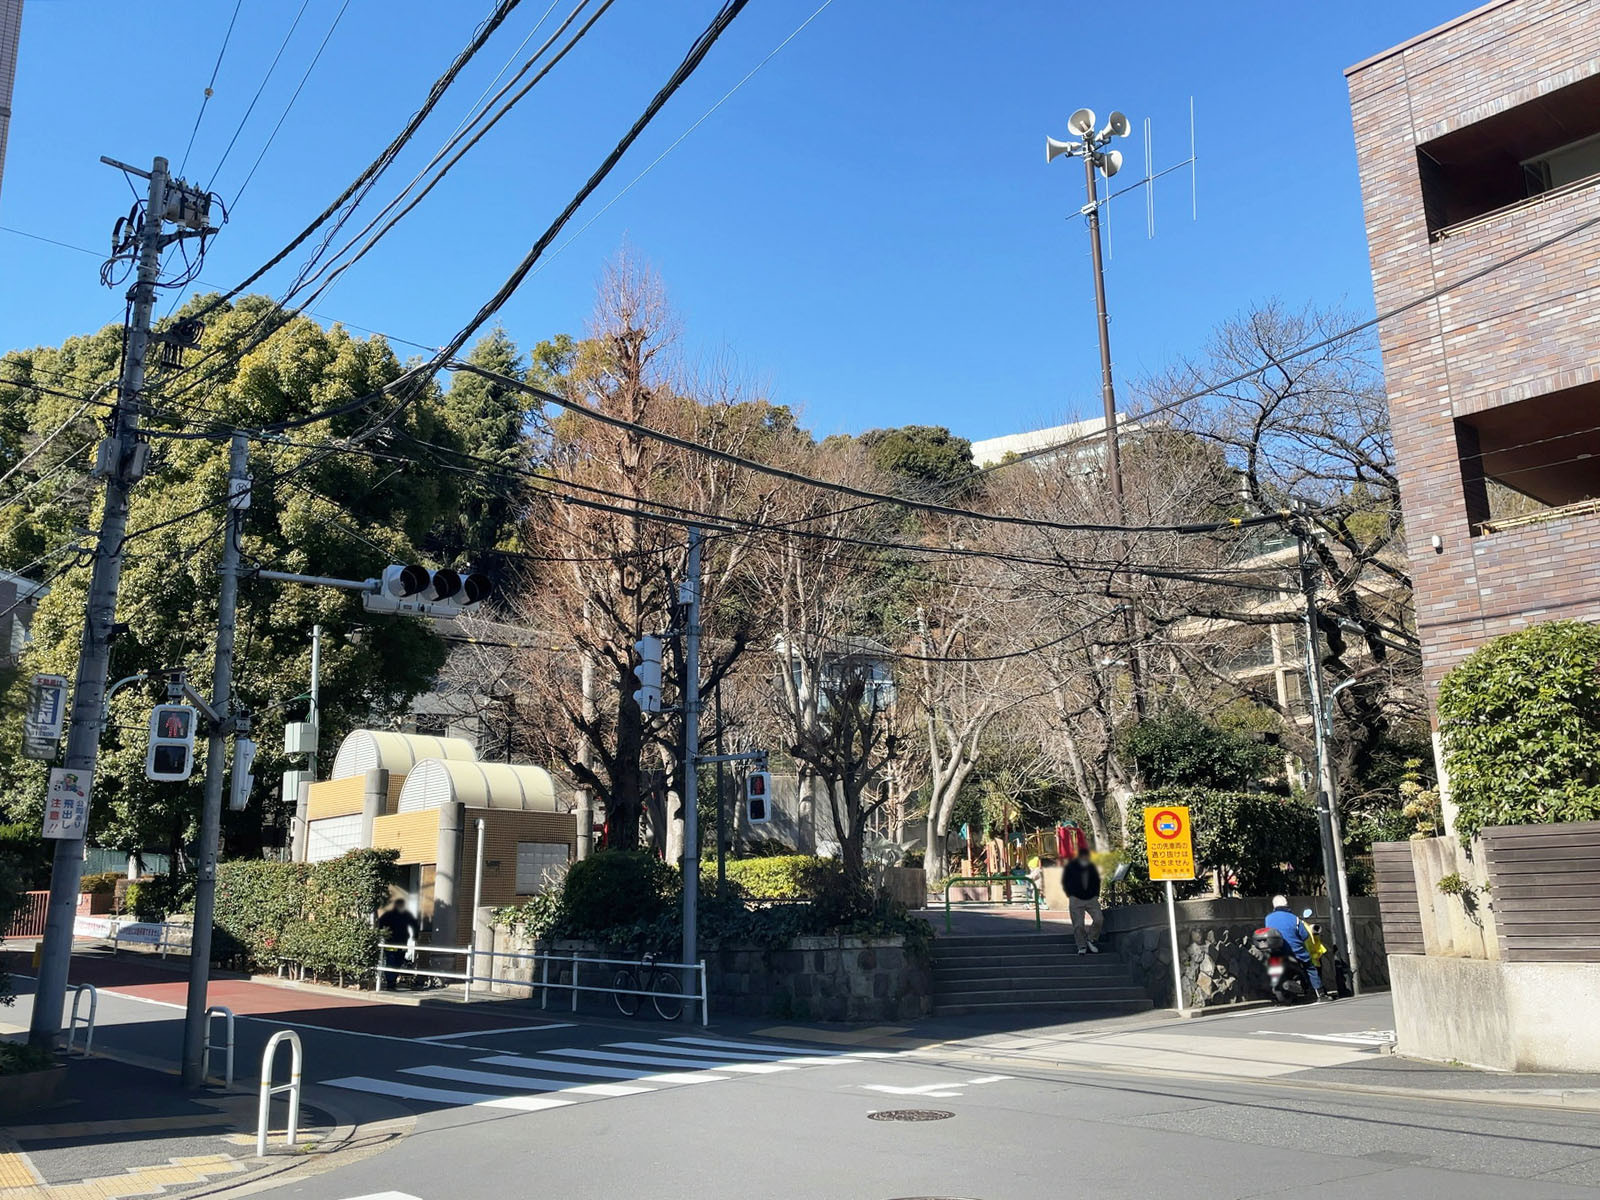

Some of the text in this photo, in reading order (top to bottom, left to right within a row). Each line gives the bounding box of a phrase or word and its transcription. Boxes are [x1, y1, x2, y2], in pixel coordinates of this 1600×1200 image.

[38, 689, 56, 724] KEN
[62, 799, 74, 829] 飛出し
[74, 800, 84, 828] 公園あり
[1152, 851, 1188, 859] 通り抜けは
